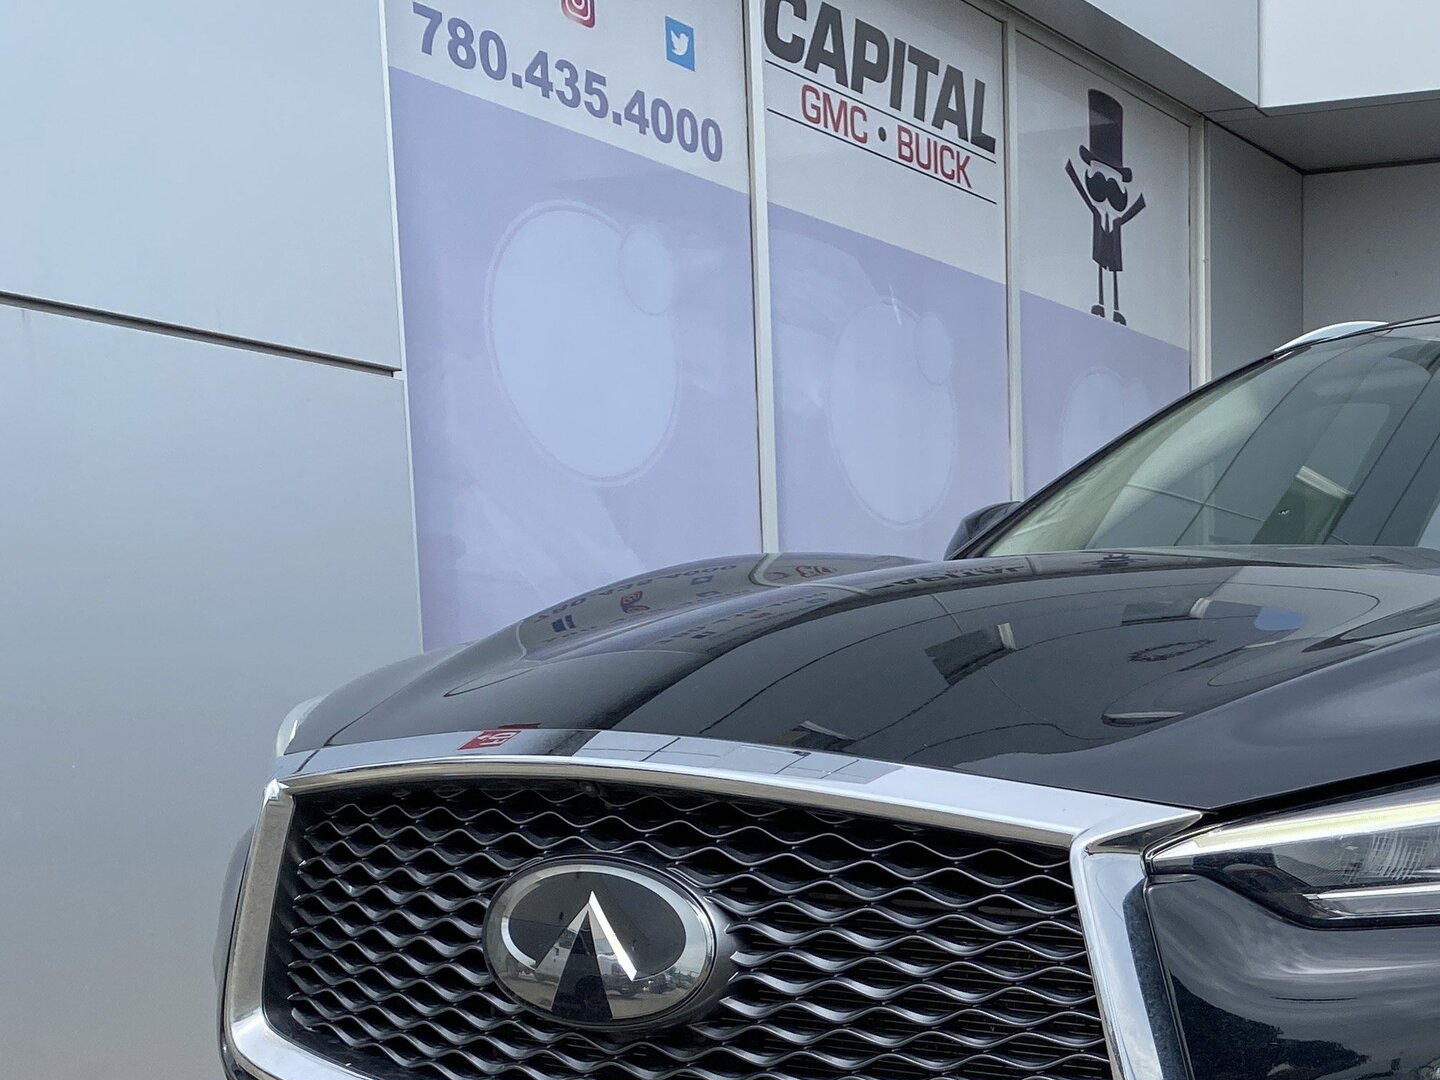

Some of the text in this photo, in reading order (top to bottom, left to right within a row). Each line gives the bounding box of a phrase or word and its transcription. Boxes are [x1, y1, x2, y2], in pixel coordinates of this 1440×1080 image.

[412, 1, 723, 162] 780.435.4000
[764, 0, 996, 154] CAPITAL
[801, 84, 972, 189] GMC BUICK
